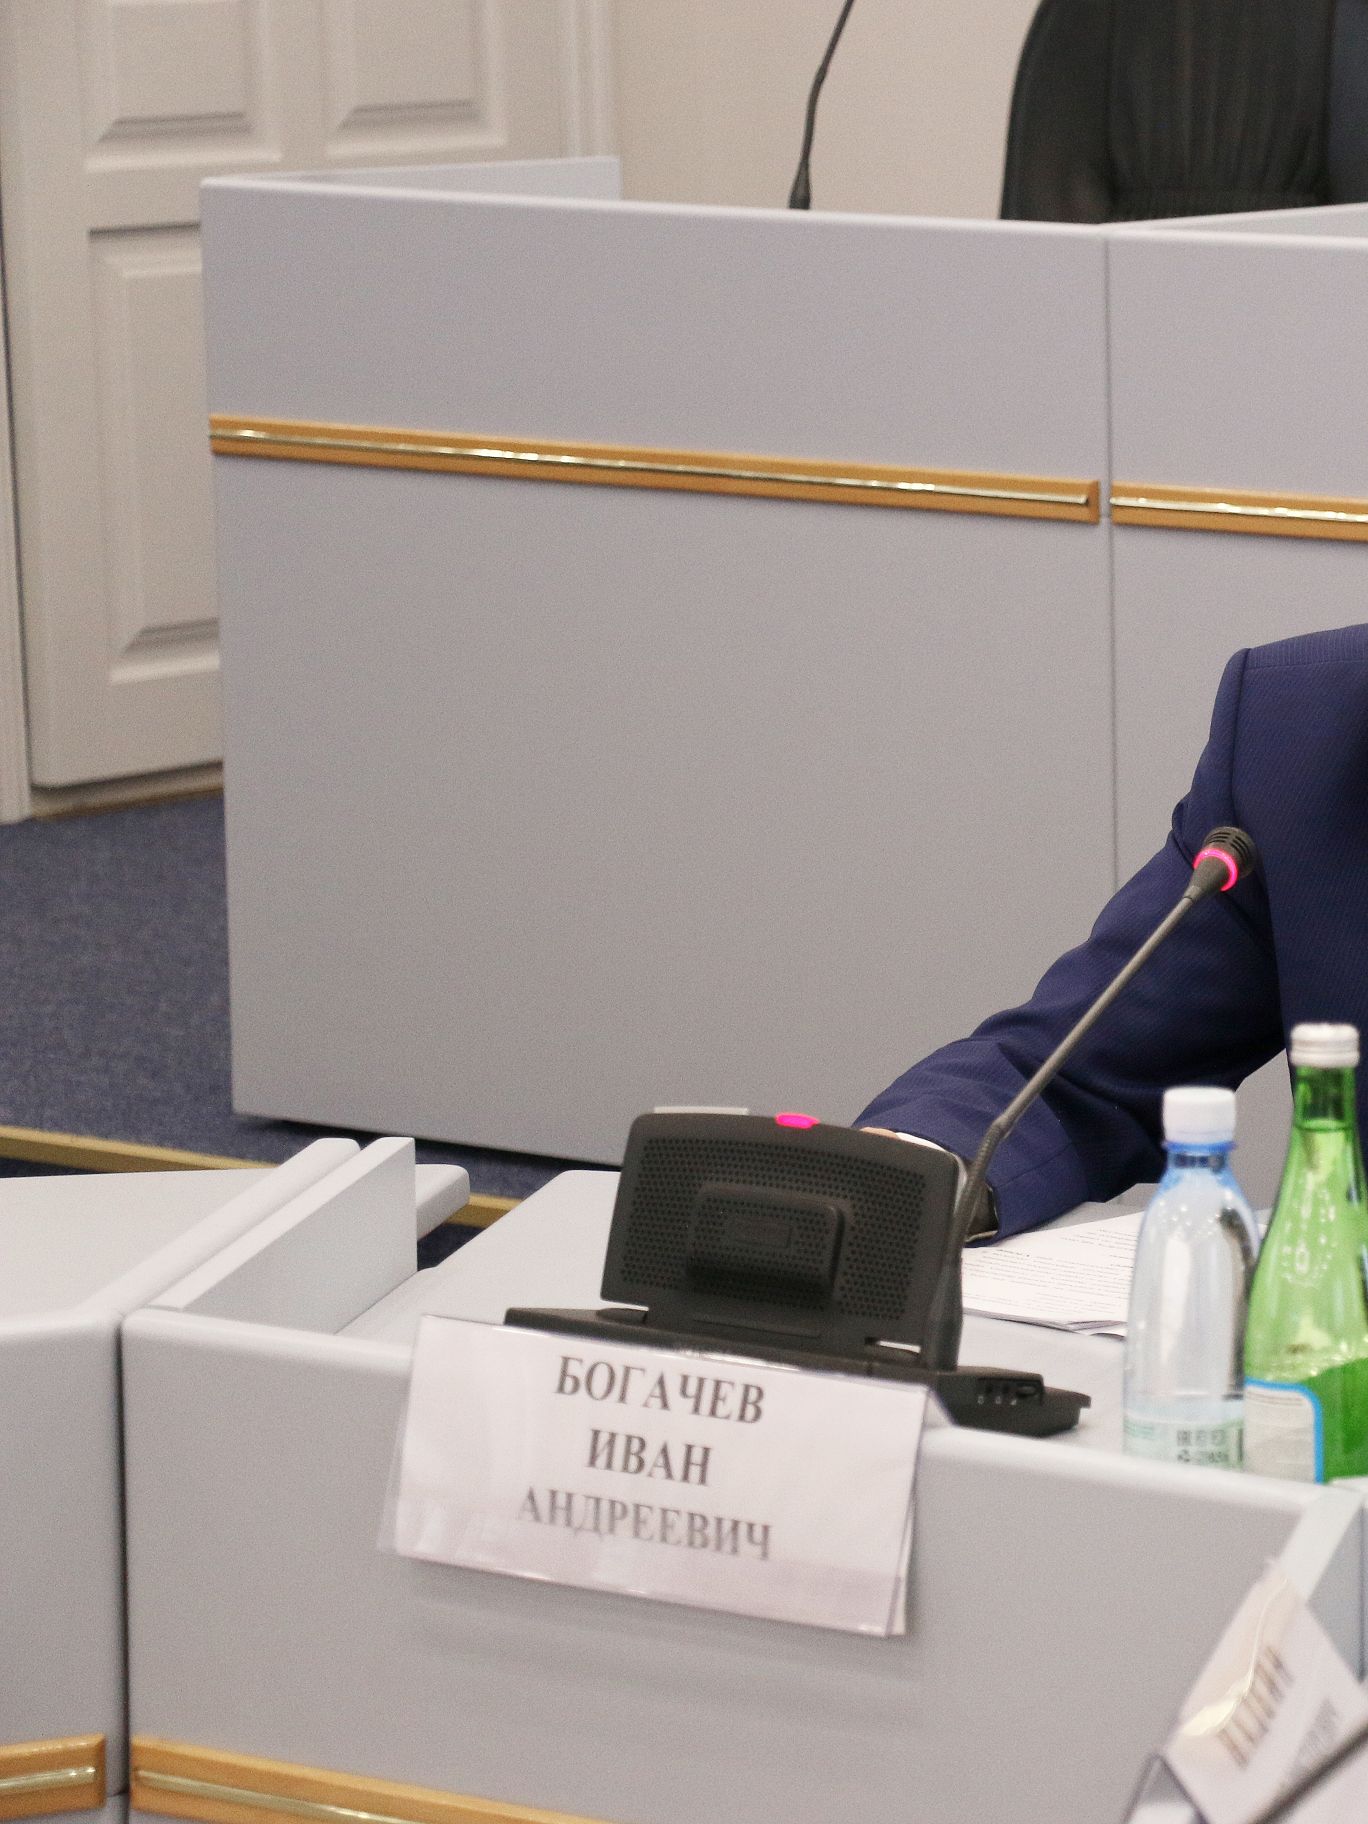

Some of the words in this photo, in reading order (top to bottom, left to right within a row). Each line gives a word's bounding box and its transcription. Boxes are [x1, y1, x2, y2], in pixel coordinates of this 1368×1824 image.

[555, 1356, 764, 1423] БОГАЧЕВ
[587, 1429, 712, 1486] ИВАН
[519, 1486, 773, 1560] АНДРЕЕВИЧ
